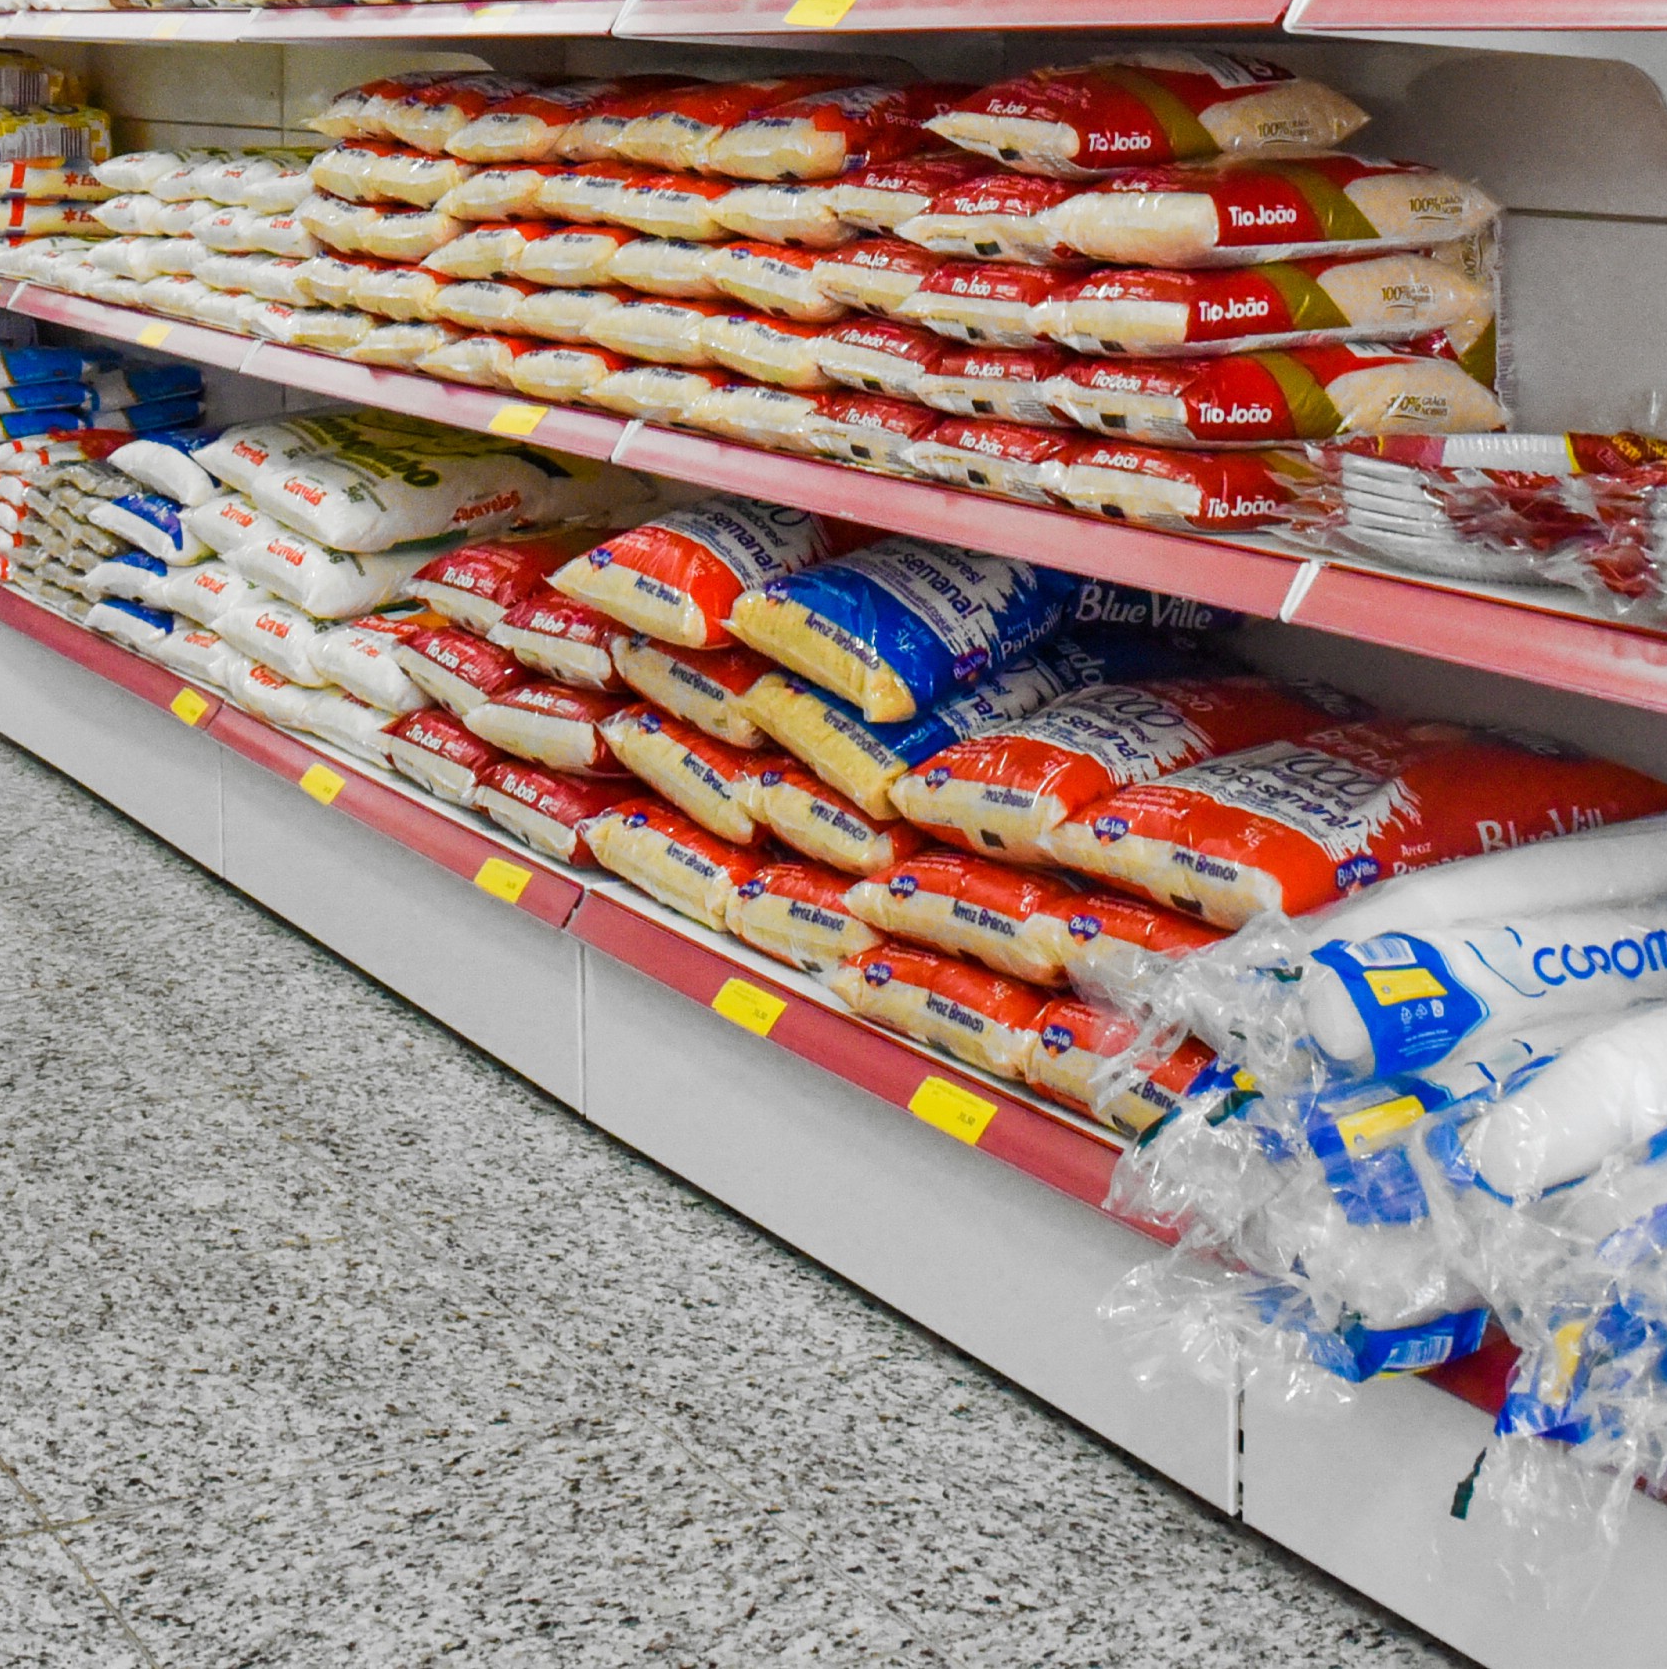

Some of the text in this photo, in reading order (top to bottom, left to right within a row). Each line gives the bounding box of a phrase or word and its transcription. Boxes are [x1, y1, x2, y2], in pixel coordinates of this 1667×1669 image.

[1088, 131, 1152, 152] Tio João
[1228, 203, 1297, 227] Tio João
[1198, 295, 1269, 322] Tio João
[1198, 402, 1272, 425] Tio João
[1207, 494, 1276, 518] Tio João
[705, 511, 782, 573] semana!
[896, 551, 984, 620] semana!
[1075, 583, 1214, 631] Blue Ville
[1400, 840, 1432, 859] Arroz
